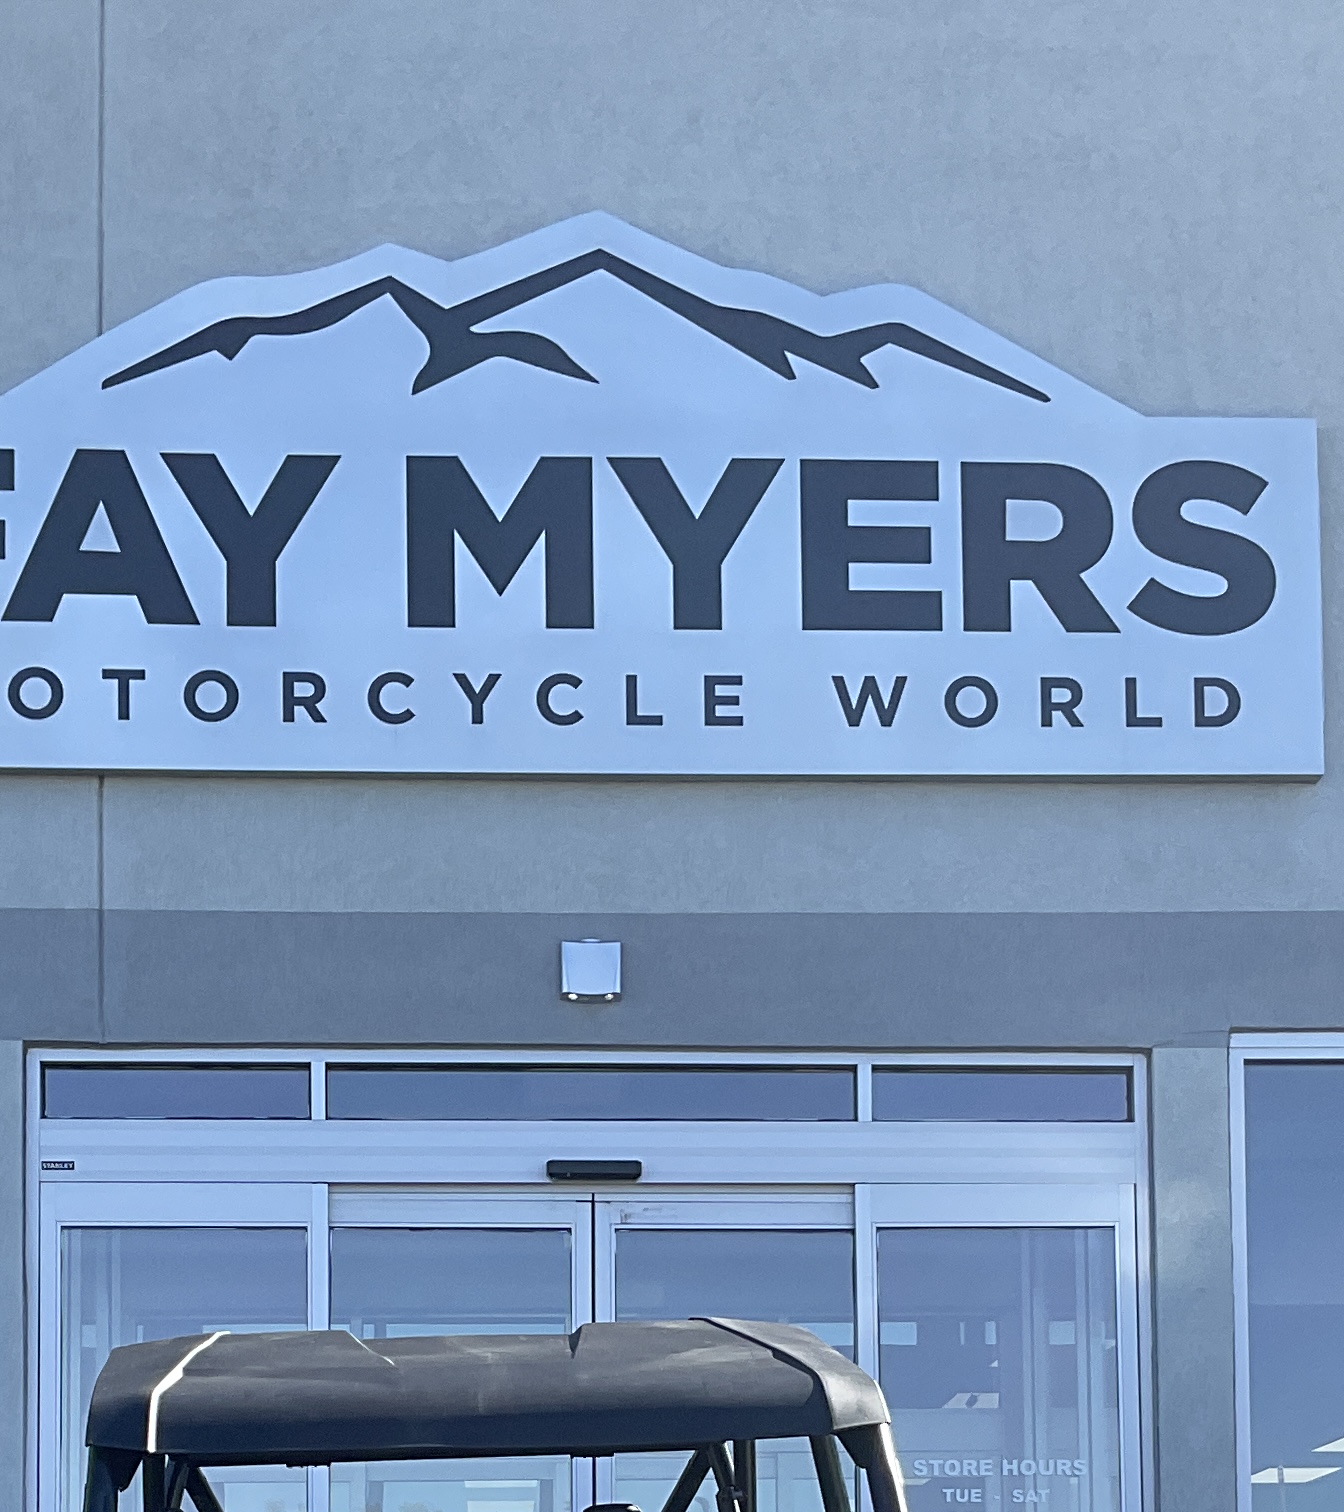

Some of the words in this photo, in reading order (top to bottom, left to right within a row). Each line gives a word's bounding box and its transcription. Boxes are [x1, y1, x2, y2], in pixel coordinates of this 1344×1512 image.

[406, 455, 1277, 637] MYERS
[831, 675, 1242, 729] WORLD
[913, 1459, 994, 1476] STORE
[1002, 1459, 1088, 1476] HOURS
[942, 1488, 982, 1502] TUE
[1012, 1489, 1051, 1502] SAT
